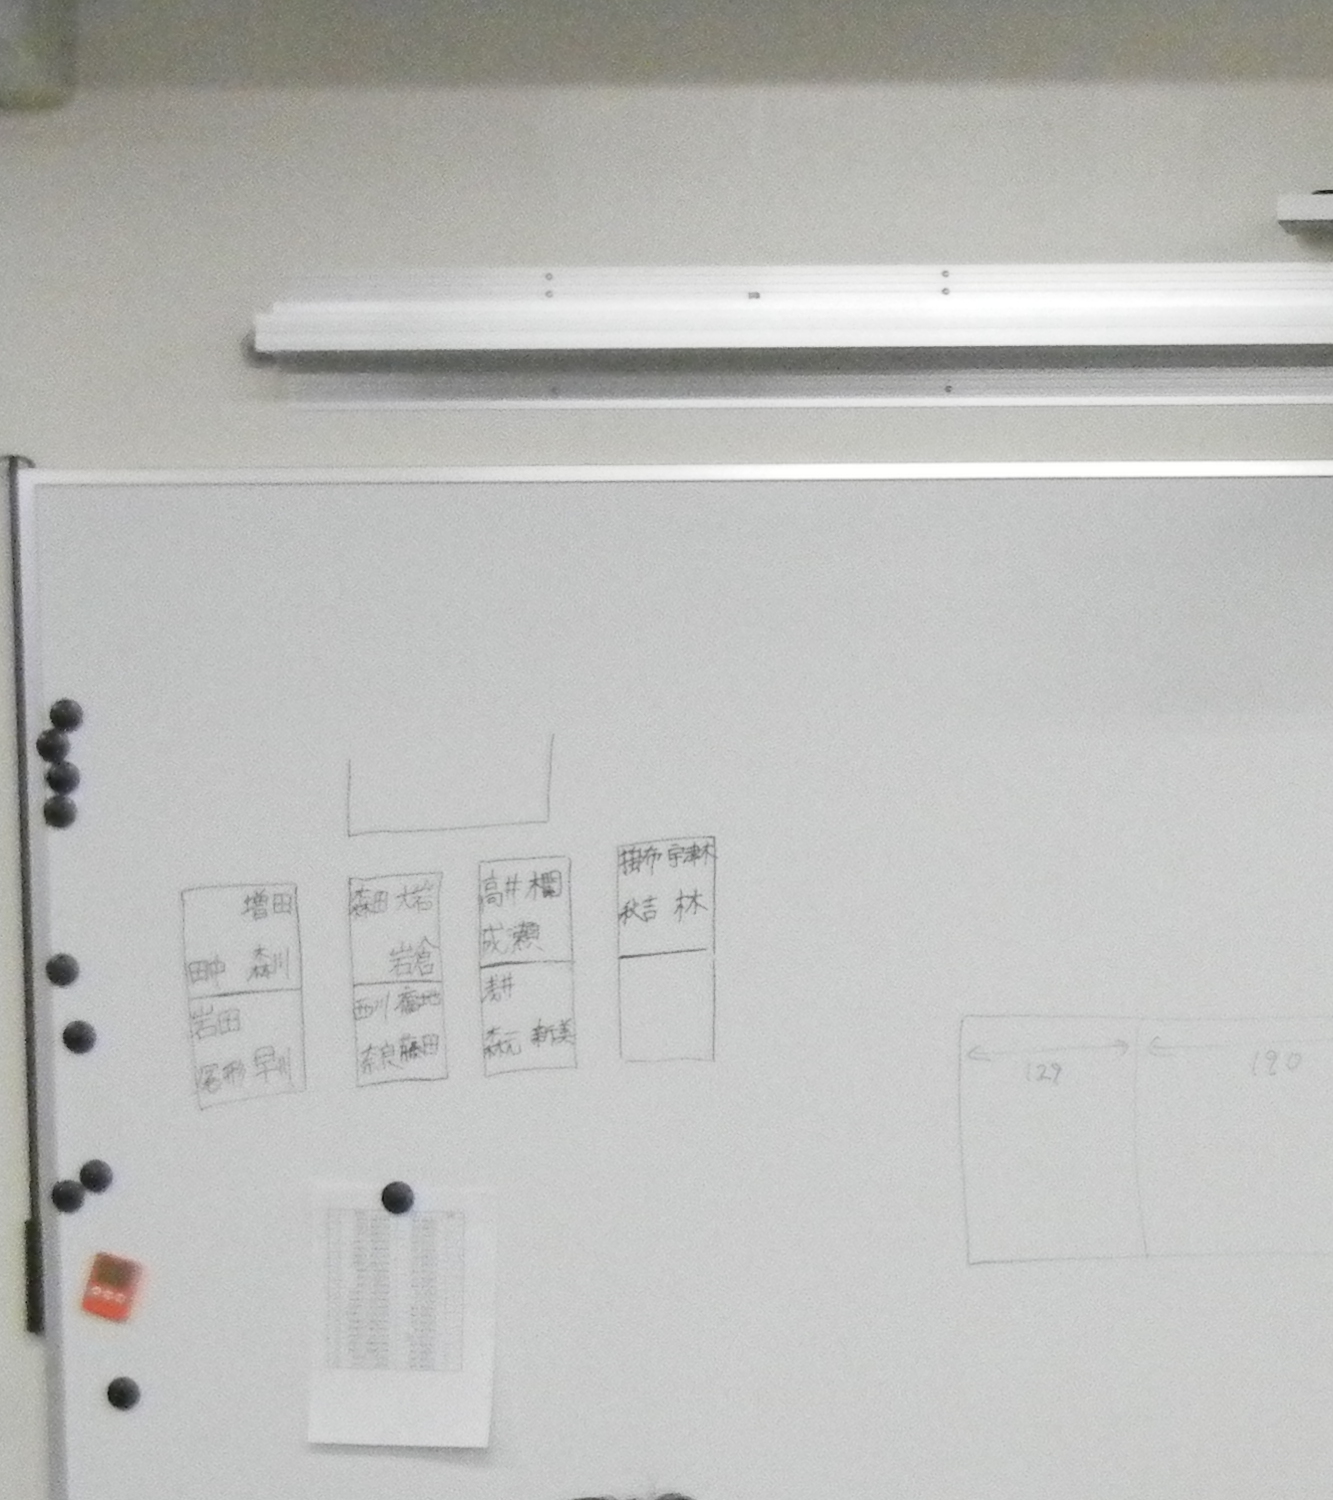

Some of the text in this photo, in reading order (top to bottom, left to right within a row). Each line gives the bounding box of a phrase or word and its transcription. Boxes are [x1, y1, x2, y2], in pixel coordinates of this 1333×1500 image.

[240, 888, 293, 922] 増田
[481, 868, 523, 907] 高井
[618, 888, 709, 926] 秋吉 林
[187, 944, 290, 987] 田中 森川
[388, 935, 440, 977] 岩倉
[190, 1004, 241, 1041] 岩田
[352, 990, 390, 1022] 西川
[254, 1044, 295, 1088] 早川
[360, 1039, 403, 1075] 奈良
[1025, 1061, 1064, 1086] 129
